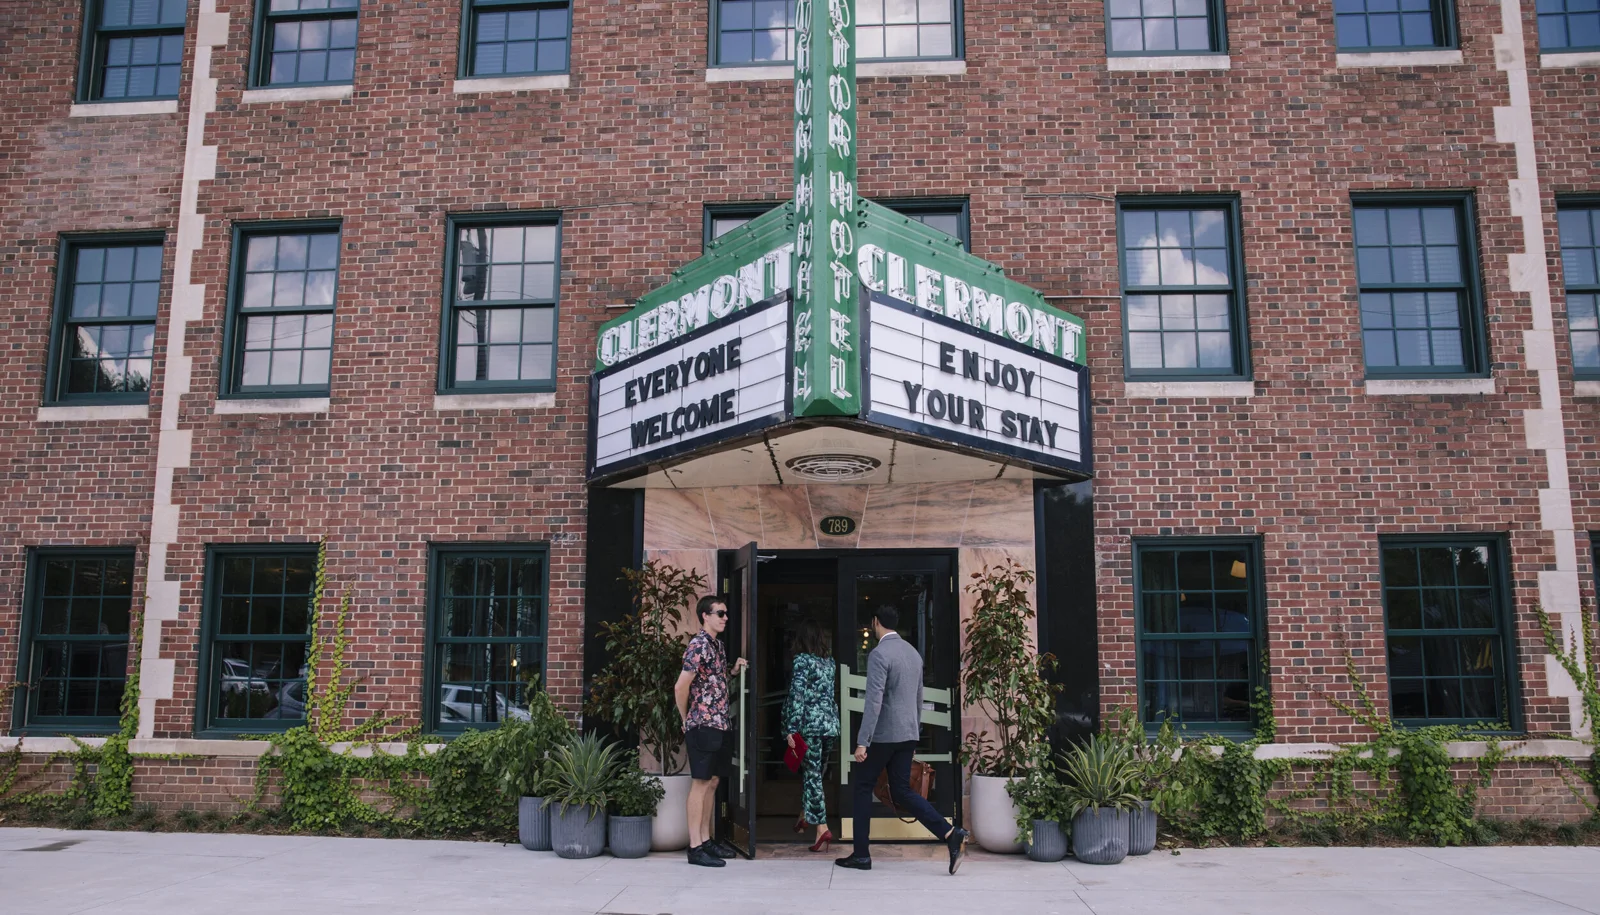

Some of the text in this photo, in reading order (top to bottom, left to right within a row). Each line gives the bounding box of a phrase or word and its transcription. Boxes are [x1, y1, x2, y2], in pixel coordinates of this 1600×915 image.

[597, 242, 794, 366] CLERMONT
[794, 171, 812, 400] HOTEL
[829, 171, 853, 399] HOTEL
[857, 243, 1083, 362] CLERMONT
[625, 337, 742, 408] EVERYONE
[940, 341, 1035, 397] ENJOY
[631, 389, 735, 449] WELCOME
[903, 380, 1059, 448] YOUR STAY
[828, 518, 848, 533] 789
